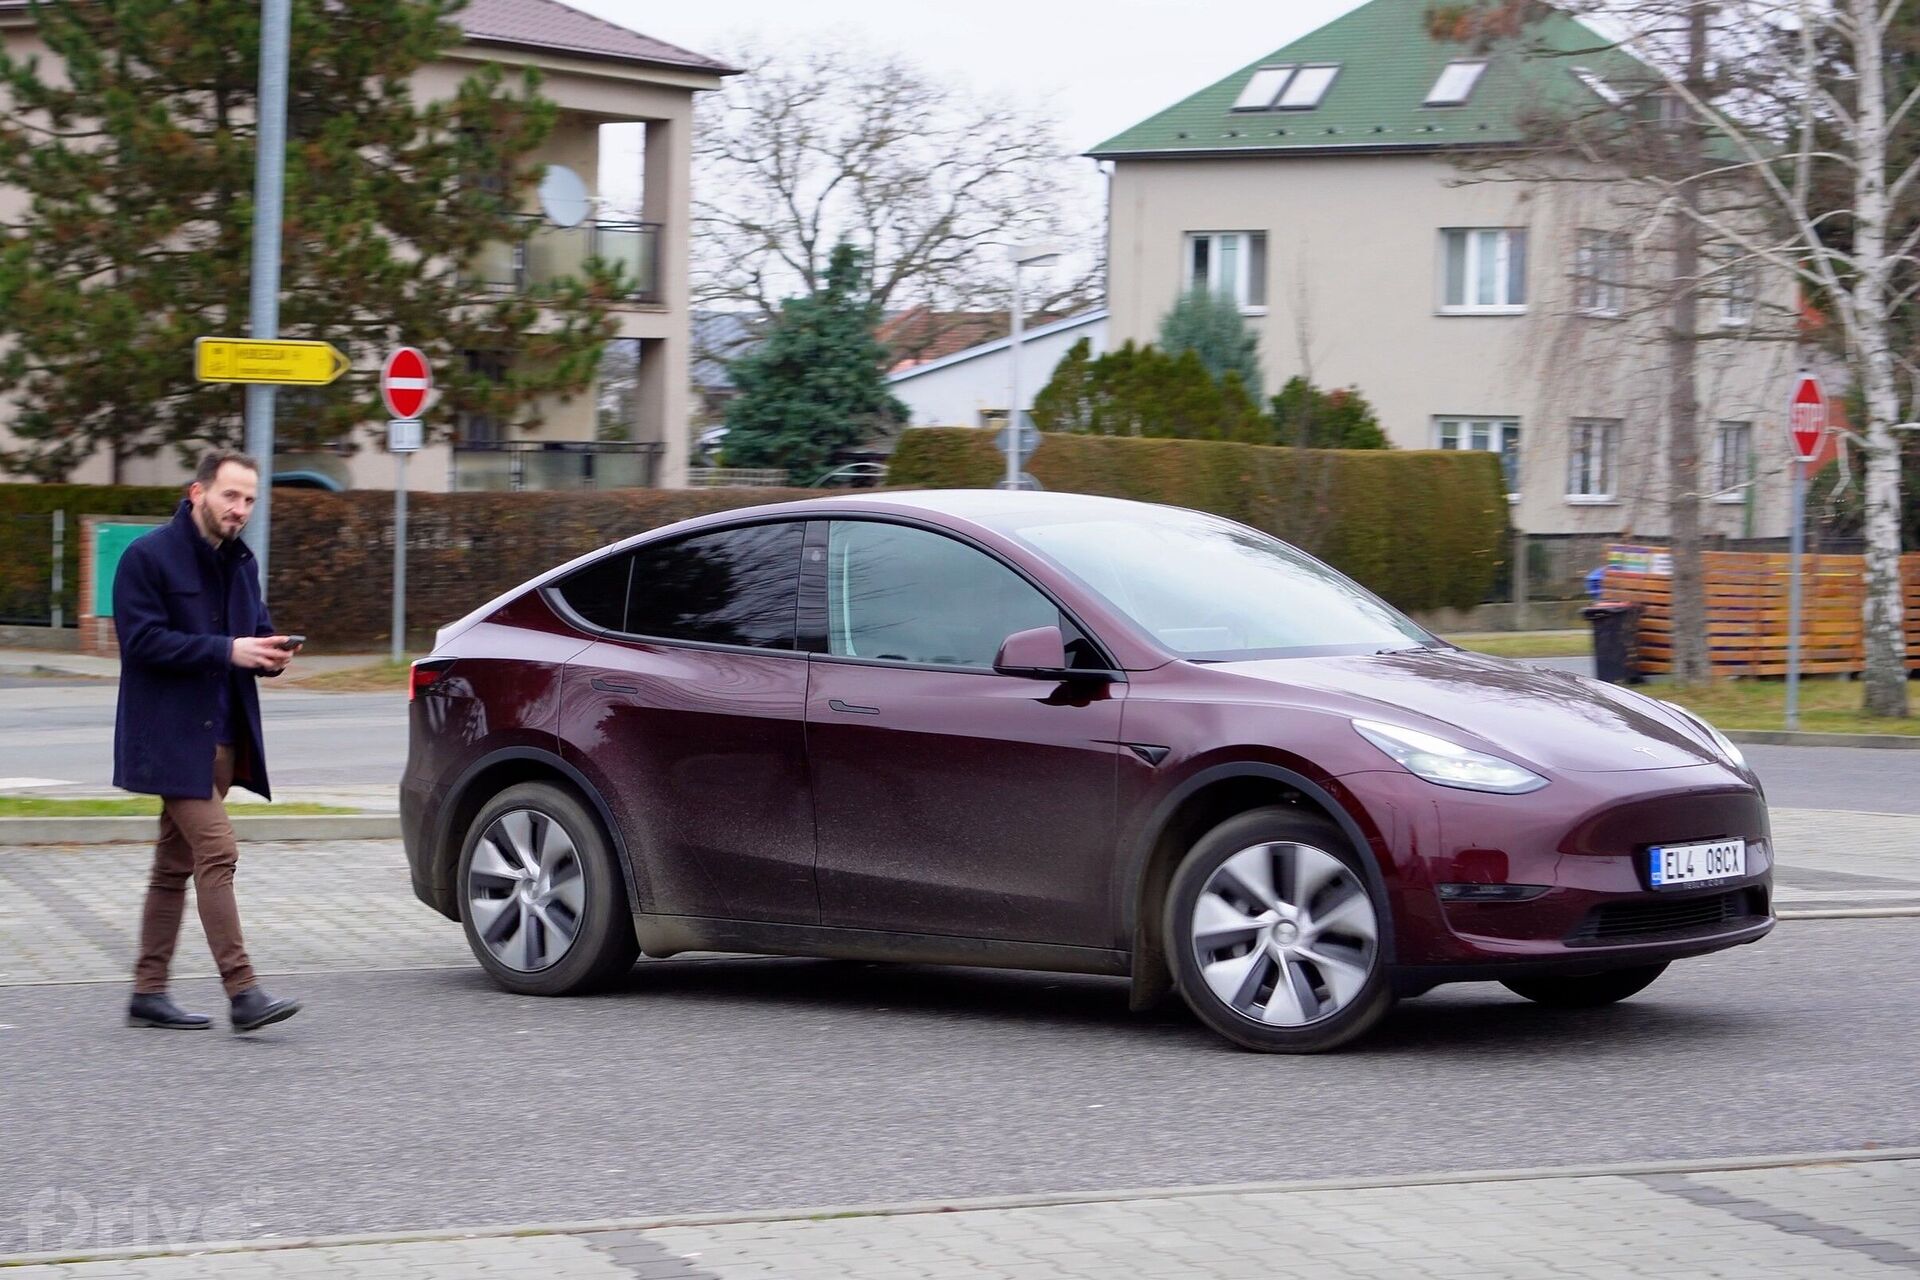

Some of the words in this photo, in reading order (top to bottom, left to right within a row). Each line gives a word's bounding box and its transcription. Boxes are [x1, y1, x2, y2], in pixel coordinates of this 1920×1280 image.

[1791, 402, 1824, 433] STOP
[1666, 850, 1694, 879] EL4
[1706, 845, 1739, 875] 08CX
